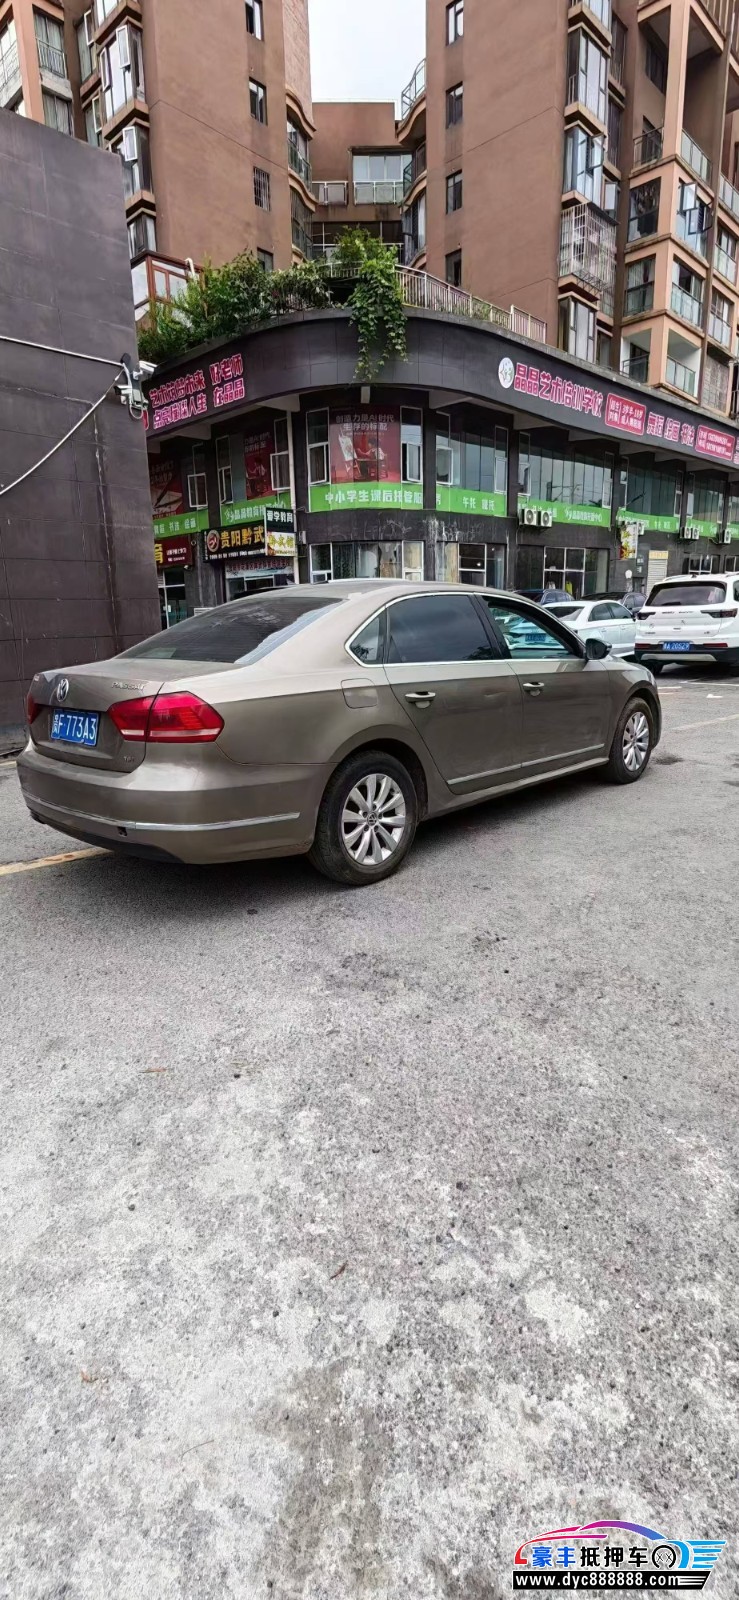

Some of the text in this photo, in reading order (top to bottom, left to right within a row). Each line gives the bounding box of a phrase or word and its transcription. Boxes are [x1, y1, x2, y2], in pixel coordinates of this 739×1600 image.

[209, 354, 243, 385] 好老师
[214, 378, 245, 407] 在晶晶
[514, 362, 603, 417] 晶晶艺术培训学校
